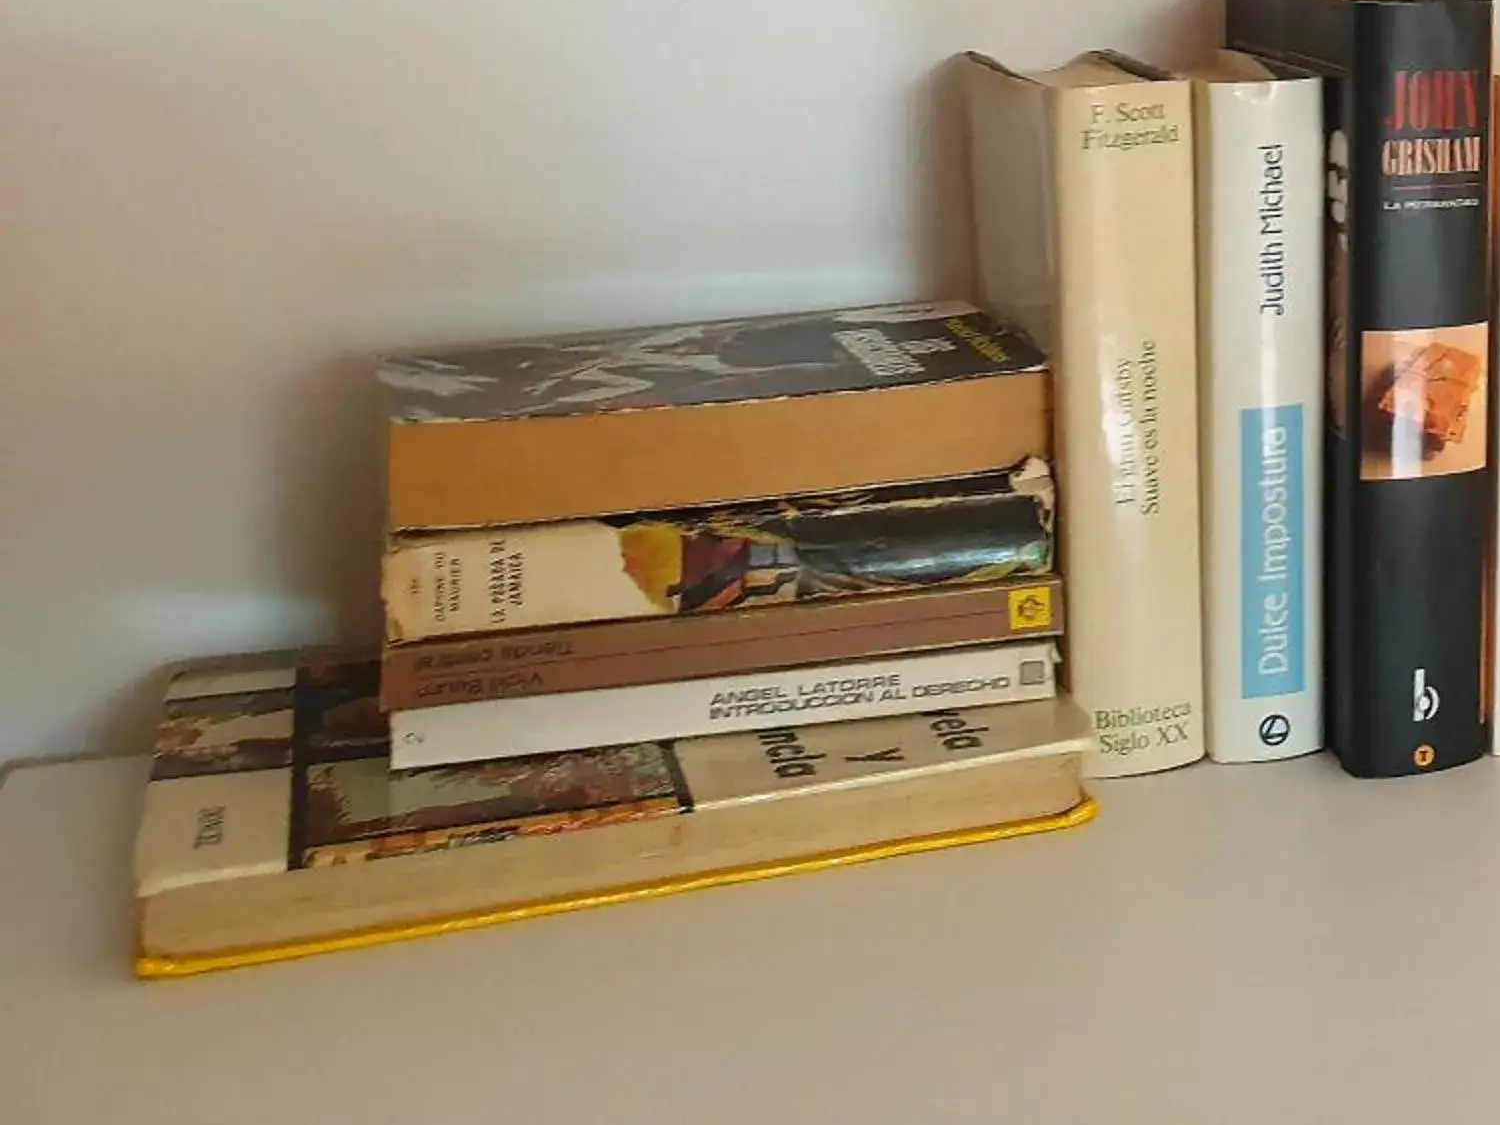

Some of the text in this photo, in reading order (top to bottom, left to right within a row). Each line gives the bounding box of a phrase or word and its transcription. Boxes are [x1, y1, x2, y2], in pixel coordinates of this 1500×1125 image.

[1382, 69, 1479, 132] JOHN
[1080, 124, 1180, 151] Fitzgerald
[1381, 136, 1481, 176] GRISHAM
[1258, 142, 1287, 316] Judith Michael
[1137, 339, 1157, 401] noche
[1258, 425, 1290, 677] Dulce Impostura
[708, 675, 1012, 721] INTRODUCCION AL DERECHO
[709, 673, 901, 706] ANGEL LATORRE
[1094, 701, 1192, 730] Biblioteca
[1099, 723, 1188, 756] Siglo XX
